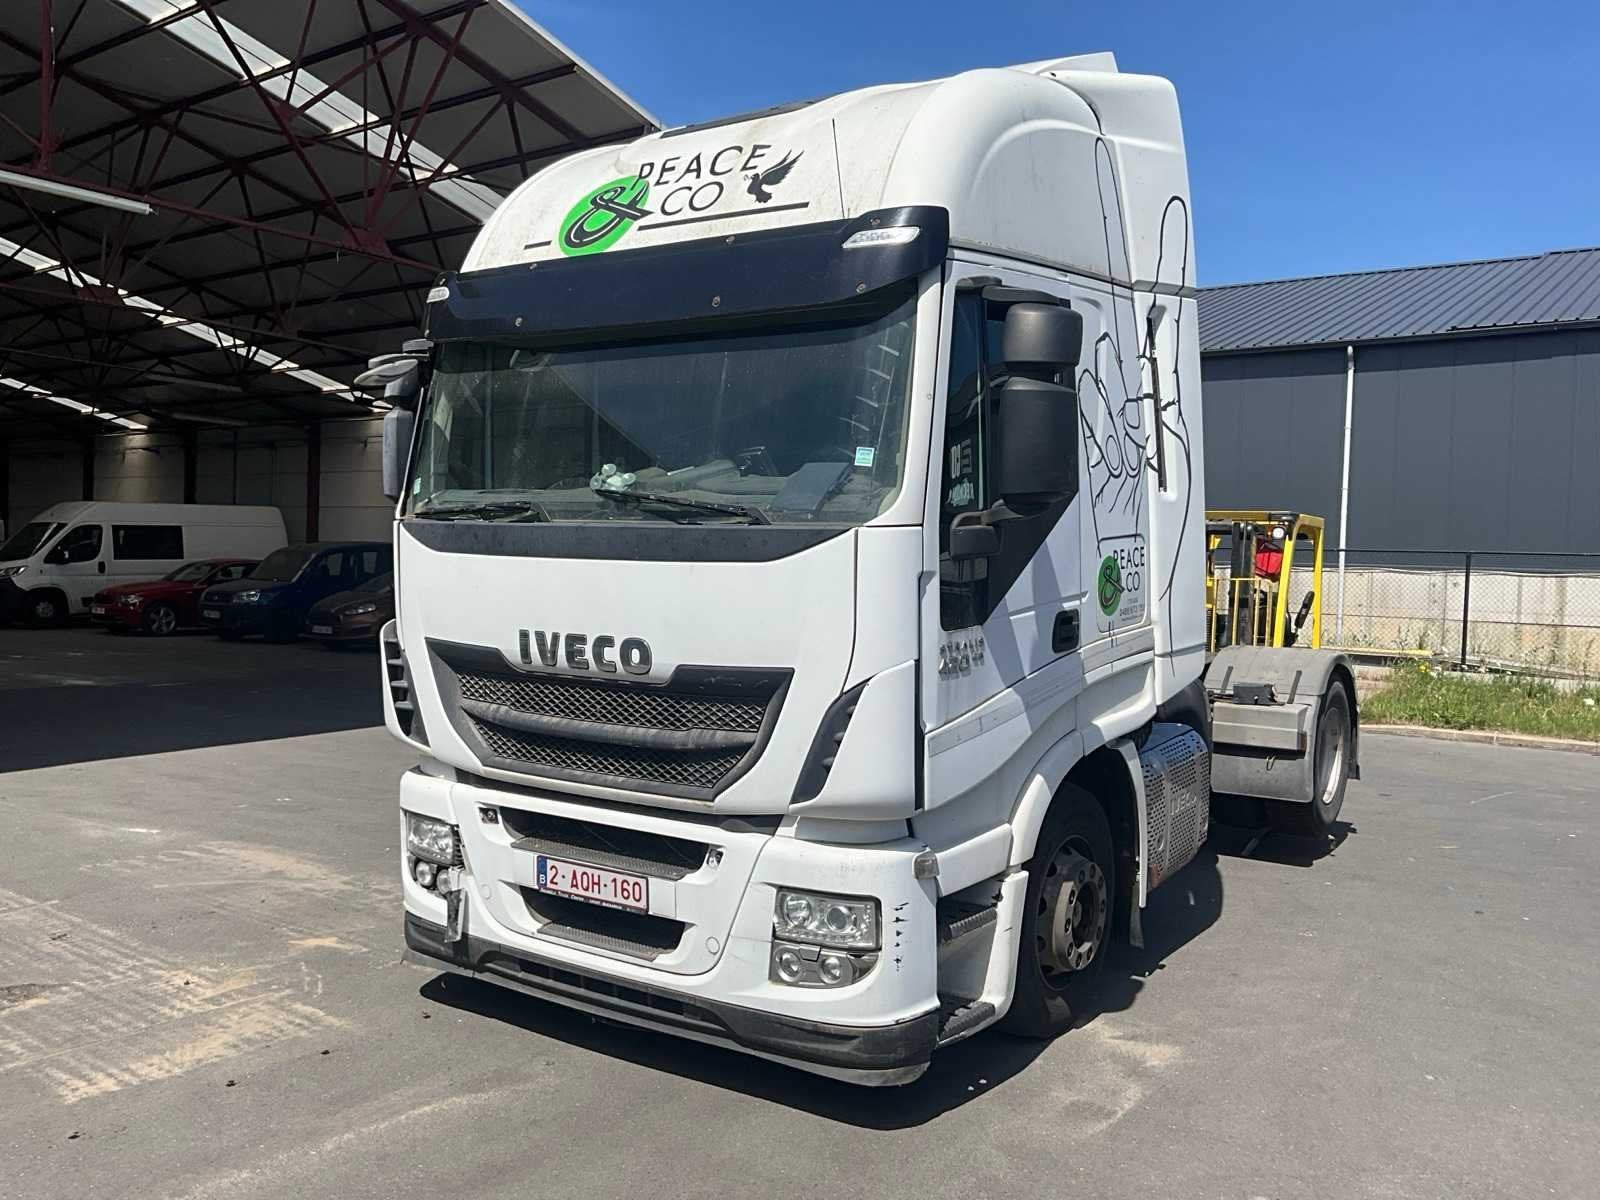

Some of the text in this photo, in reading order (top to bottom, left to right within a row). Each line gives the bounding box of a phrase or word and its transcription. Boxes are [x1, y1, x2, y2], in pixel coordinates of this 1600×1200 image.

[630, 144, 771, 190] PEACE
[660, 181, 724, 216] CO
[1113, 546, 1145, 570] PEACE
[1125, 571, 1141, 592] CO
[519, 629, 653, 675] IVECO
[539, 874, 546, 884] B
